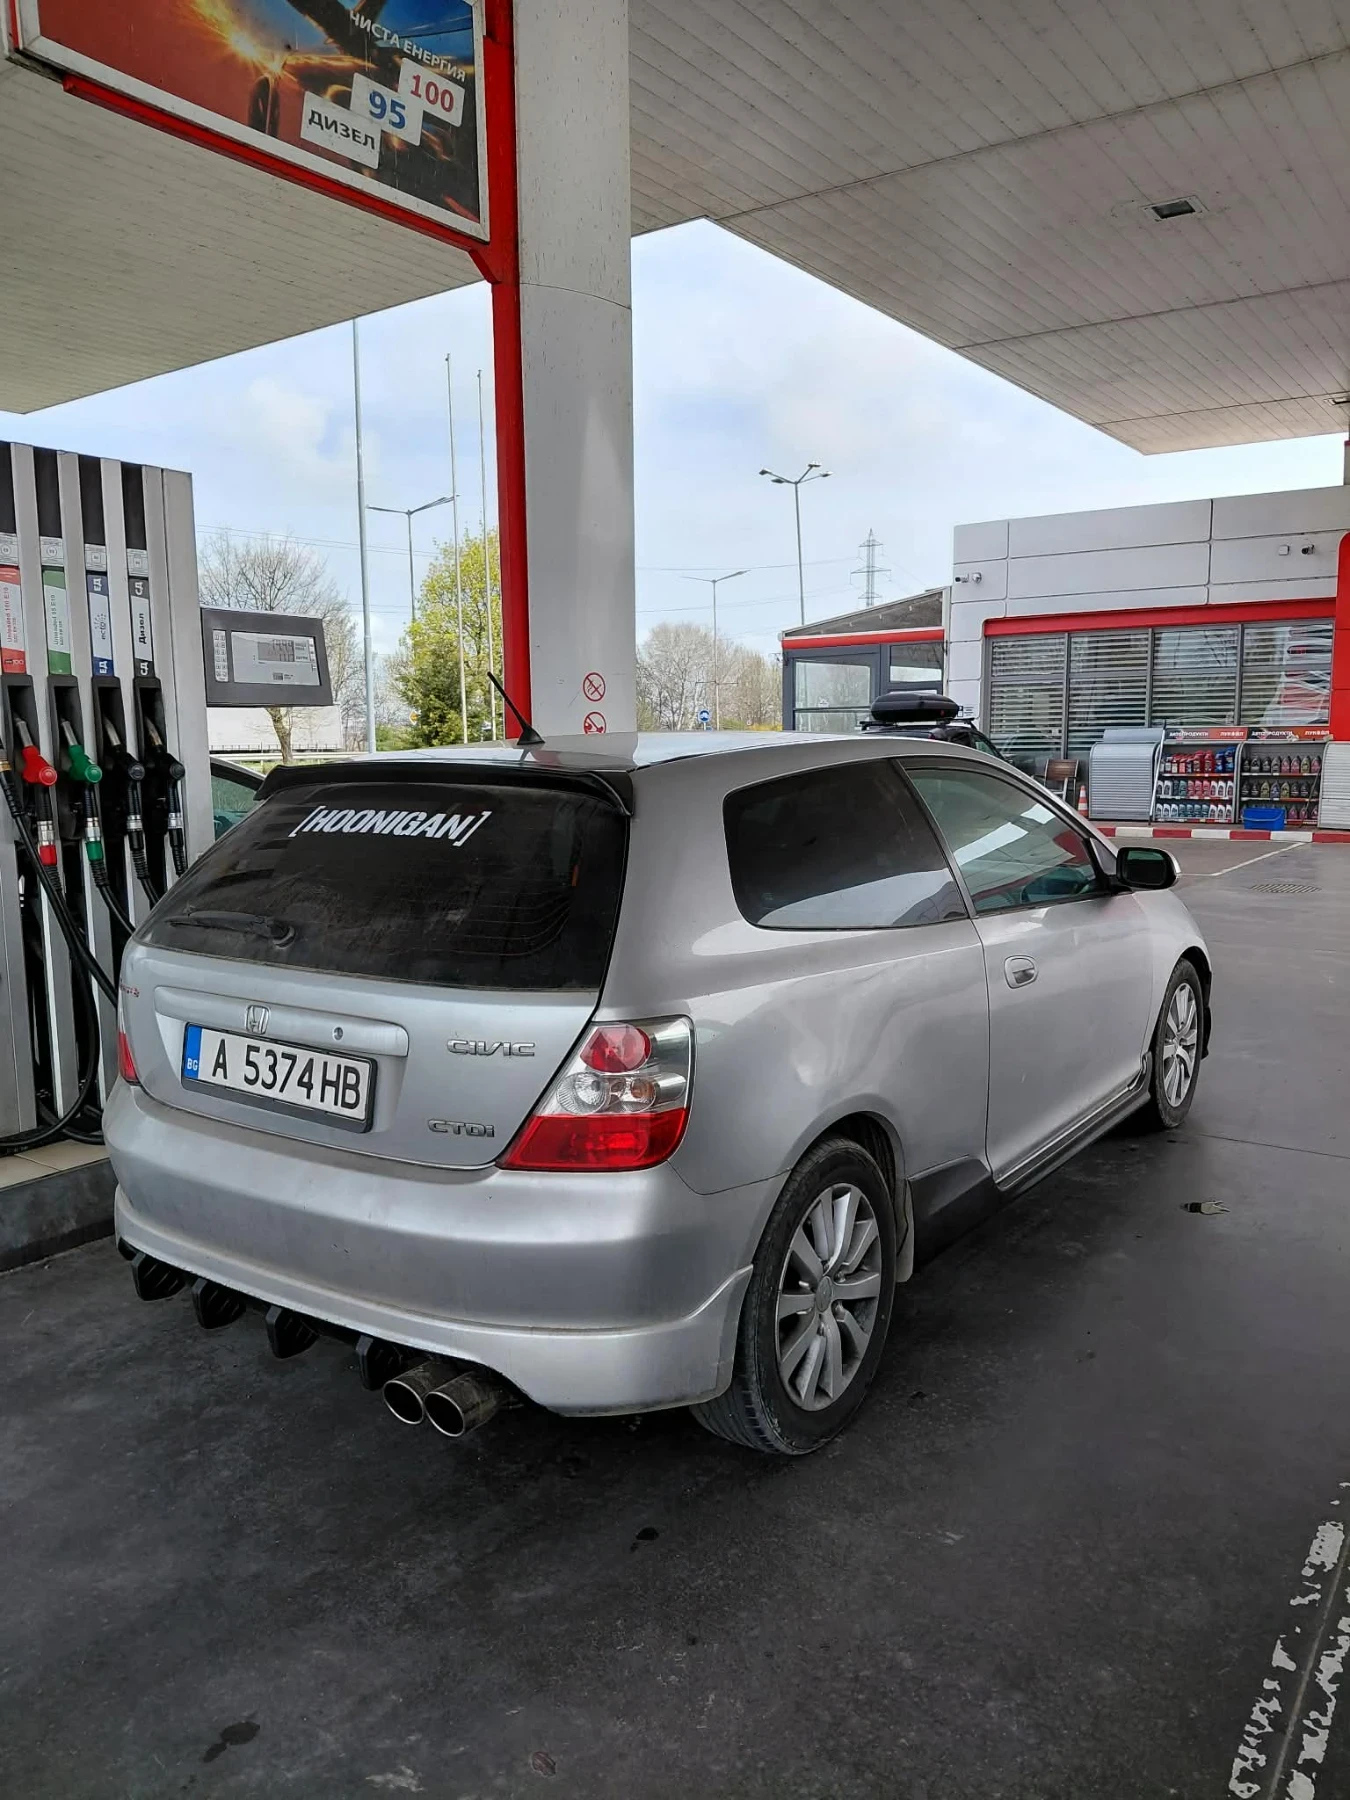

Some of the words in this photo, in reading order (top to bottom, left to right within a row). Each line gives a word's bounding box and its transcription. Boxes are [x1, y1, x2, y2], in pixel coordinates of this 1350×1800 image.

[350, 10, 400, 48] ЧИСТА
[403, 40, 466, 82] ЕНЕРГИЯ
[369, 90, 406, 129] 95
[410, 74, 454, 112] 100
[308, 110, 375, 149] ДИЗЕЛ
[187, 1057, 198, 1071] BG
[212, 1038, 228, 1080] A
[446, 1039, 536, 1057] CIVIC
